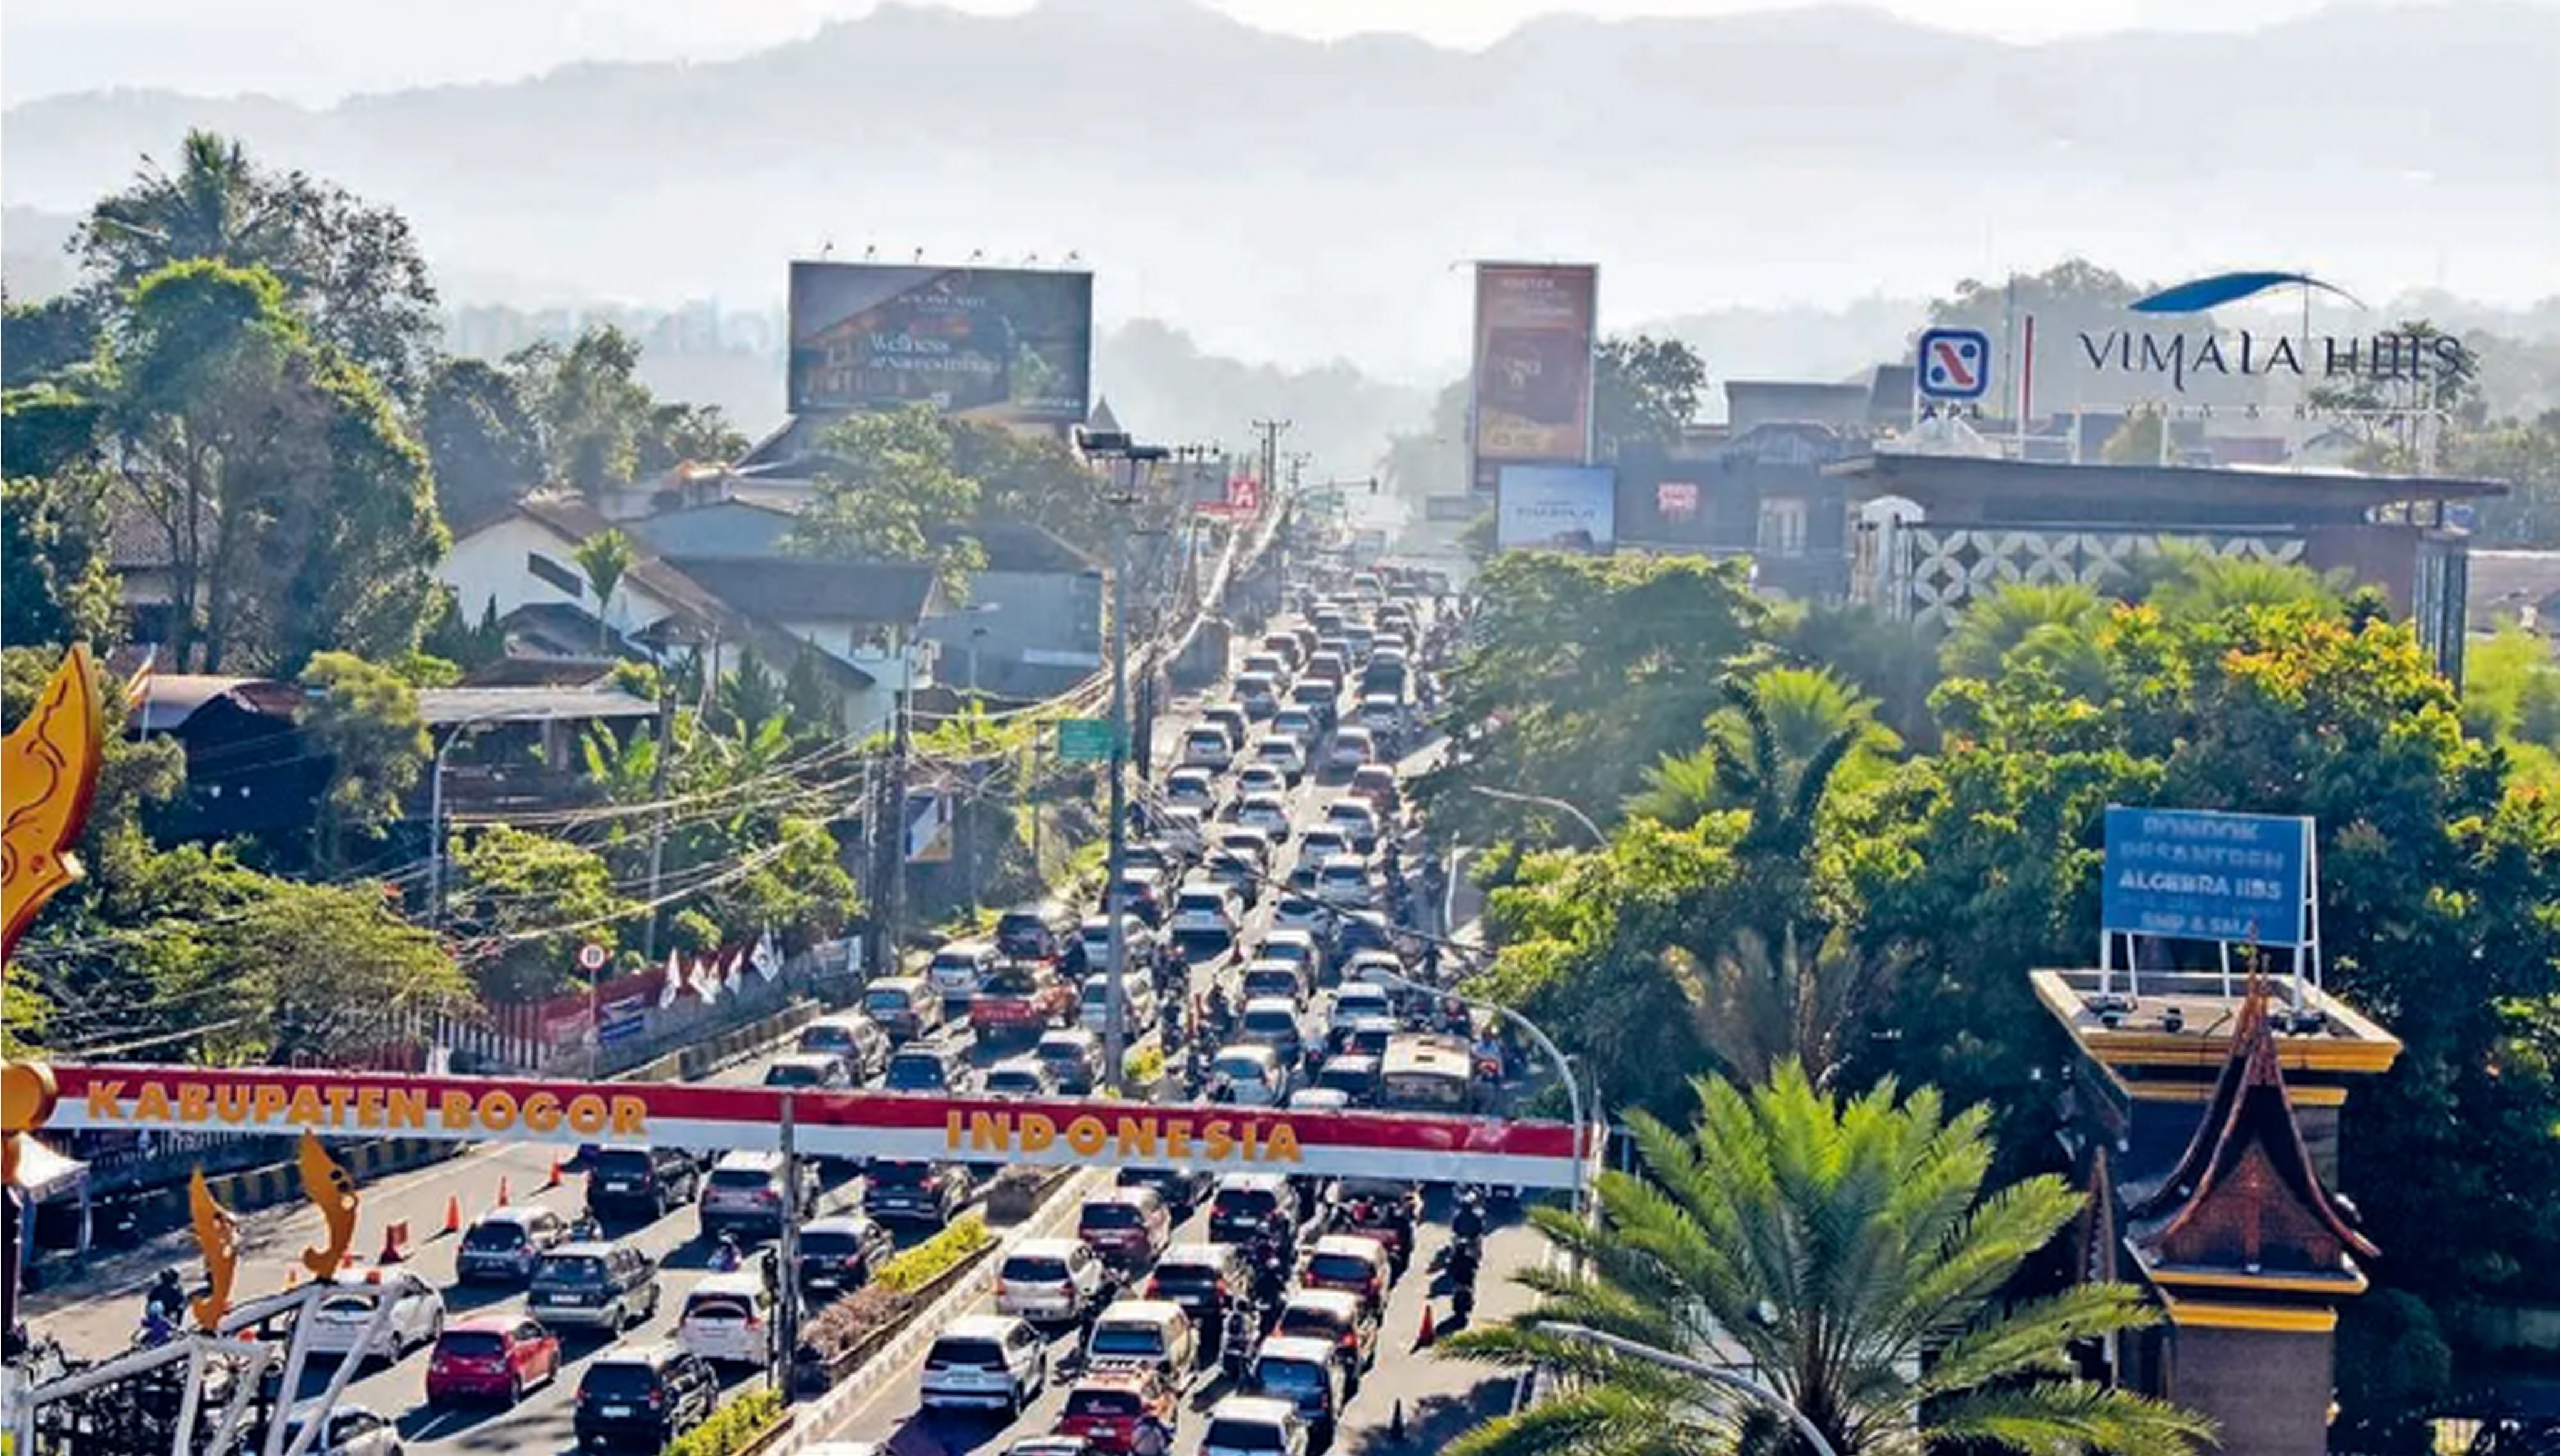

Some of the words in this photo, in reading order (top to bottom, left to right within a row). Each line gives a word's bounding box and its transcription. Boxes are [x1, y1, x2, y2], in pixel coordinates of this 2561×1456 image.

[2079, 331, 2303, 392] VIMALA
[2324, 334, 2473, 381] HILLS
[1918, 402, 1984, 424] APL
[2143, 815, 2261, 839] PONDOK
[2118, 869, 2230, 896] ALGEBRA
[2235, 878, 2282, 900] IIBS
[2140, 911, 2186, 931] SMP
[88, 1080, 427, 1129] KABUPATEN
[441, 1090, 648, 1138] BOGOR
[947, 1110, 1302, 1162] INDONESIA
